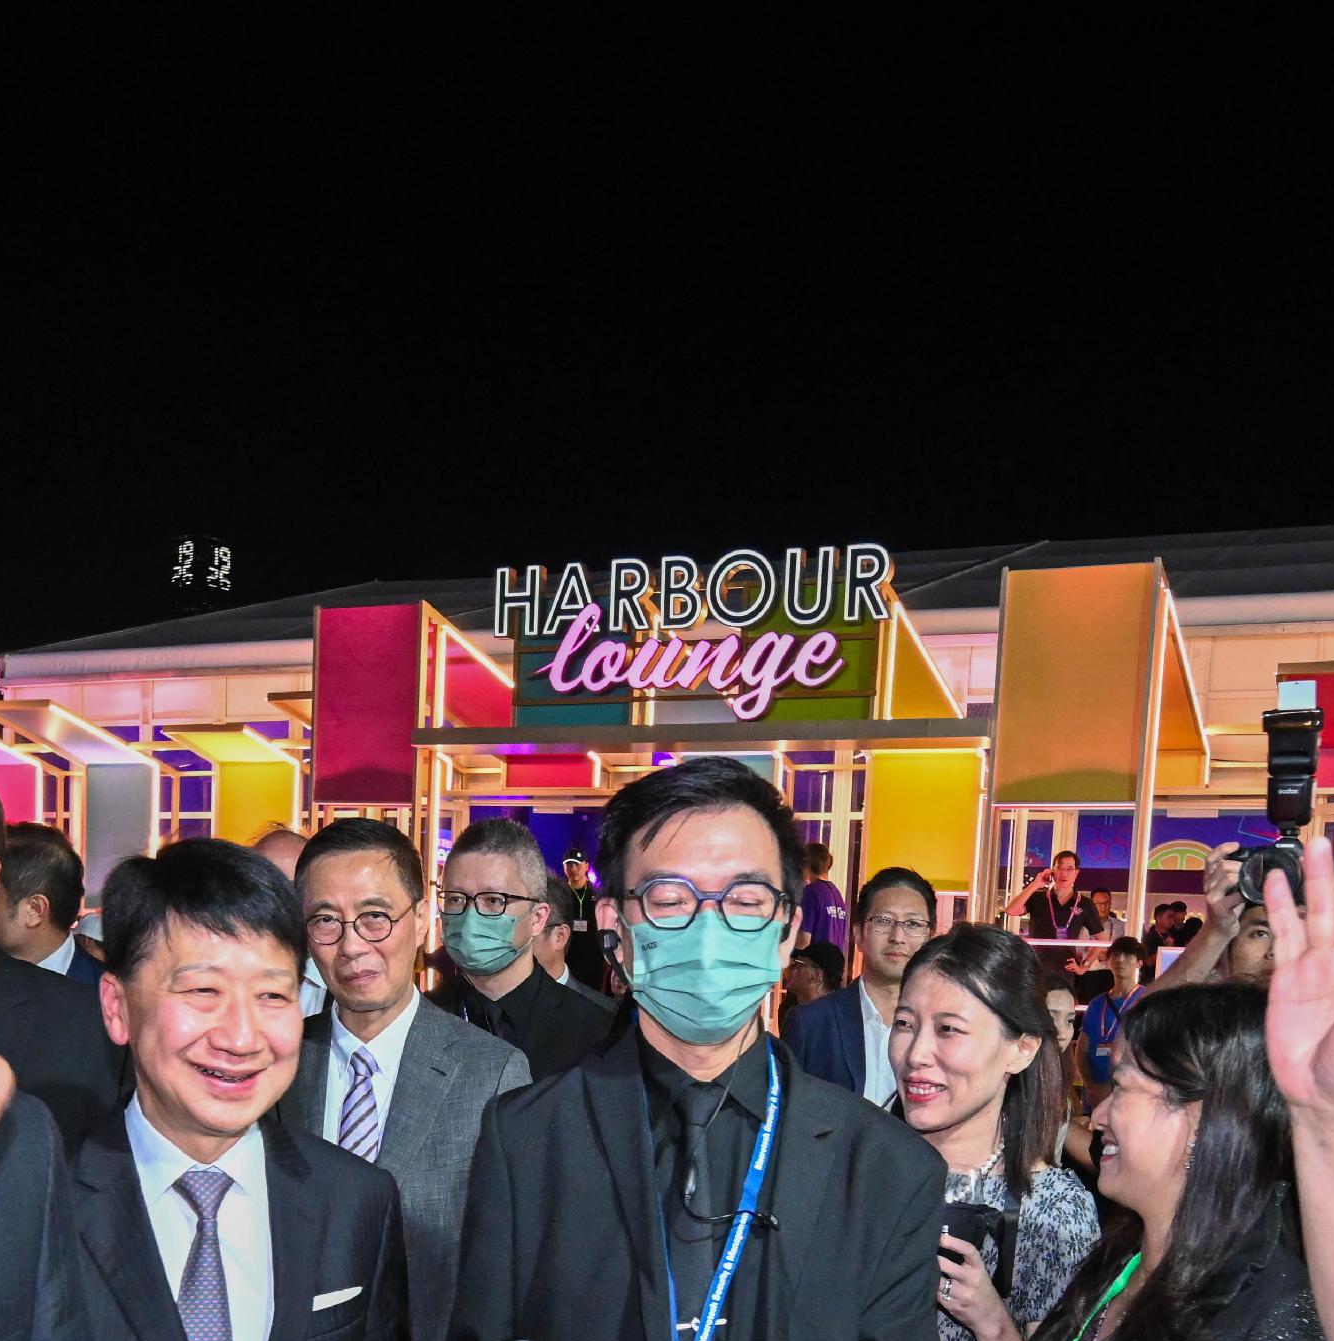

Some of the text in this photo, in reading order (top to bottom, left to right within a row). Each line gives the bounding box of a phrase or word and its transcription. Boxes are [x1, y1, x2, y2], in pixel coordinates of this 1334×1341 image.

[494, 543, 893, 637] HARBOUR
[534, 602, 844, 722] lounge
[711, 1271, 731, 1302] Security
